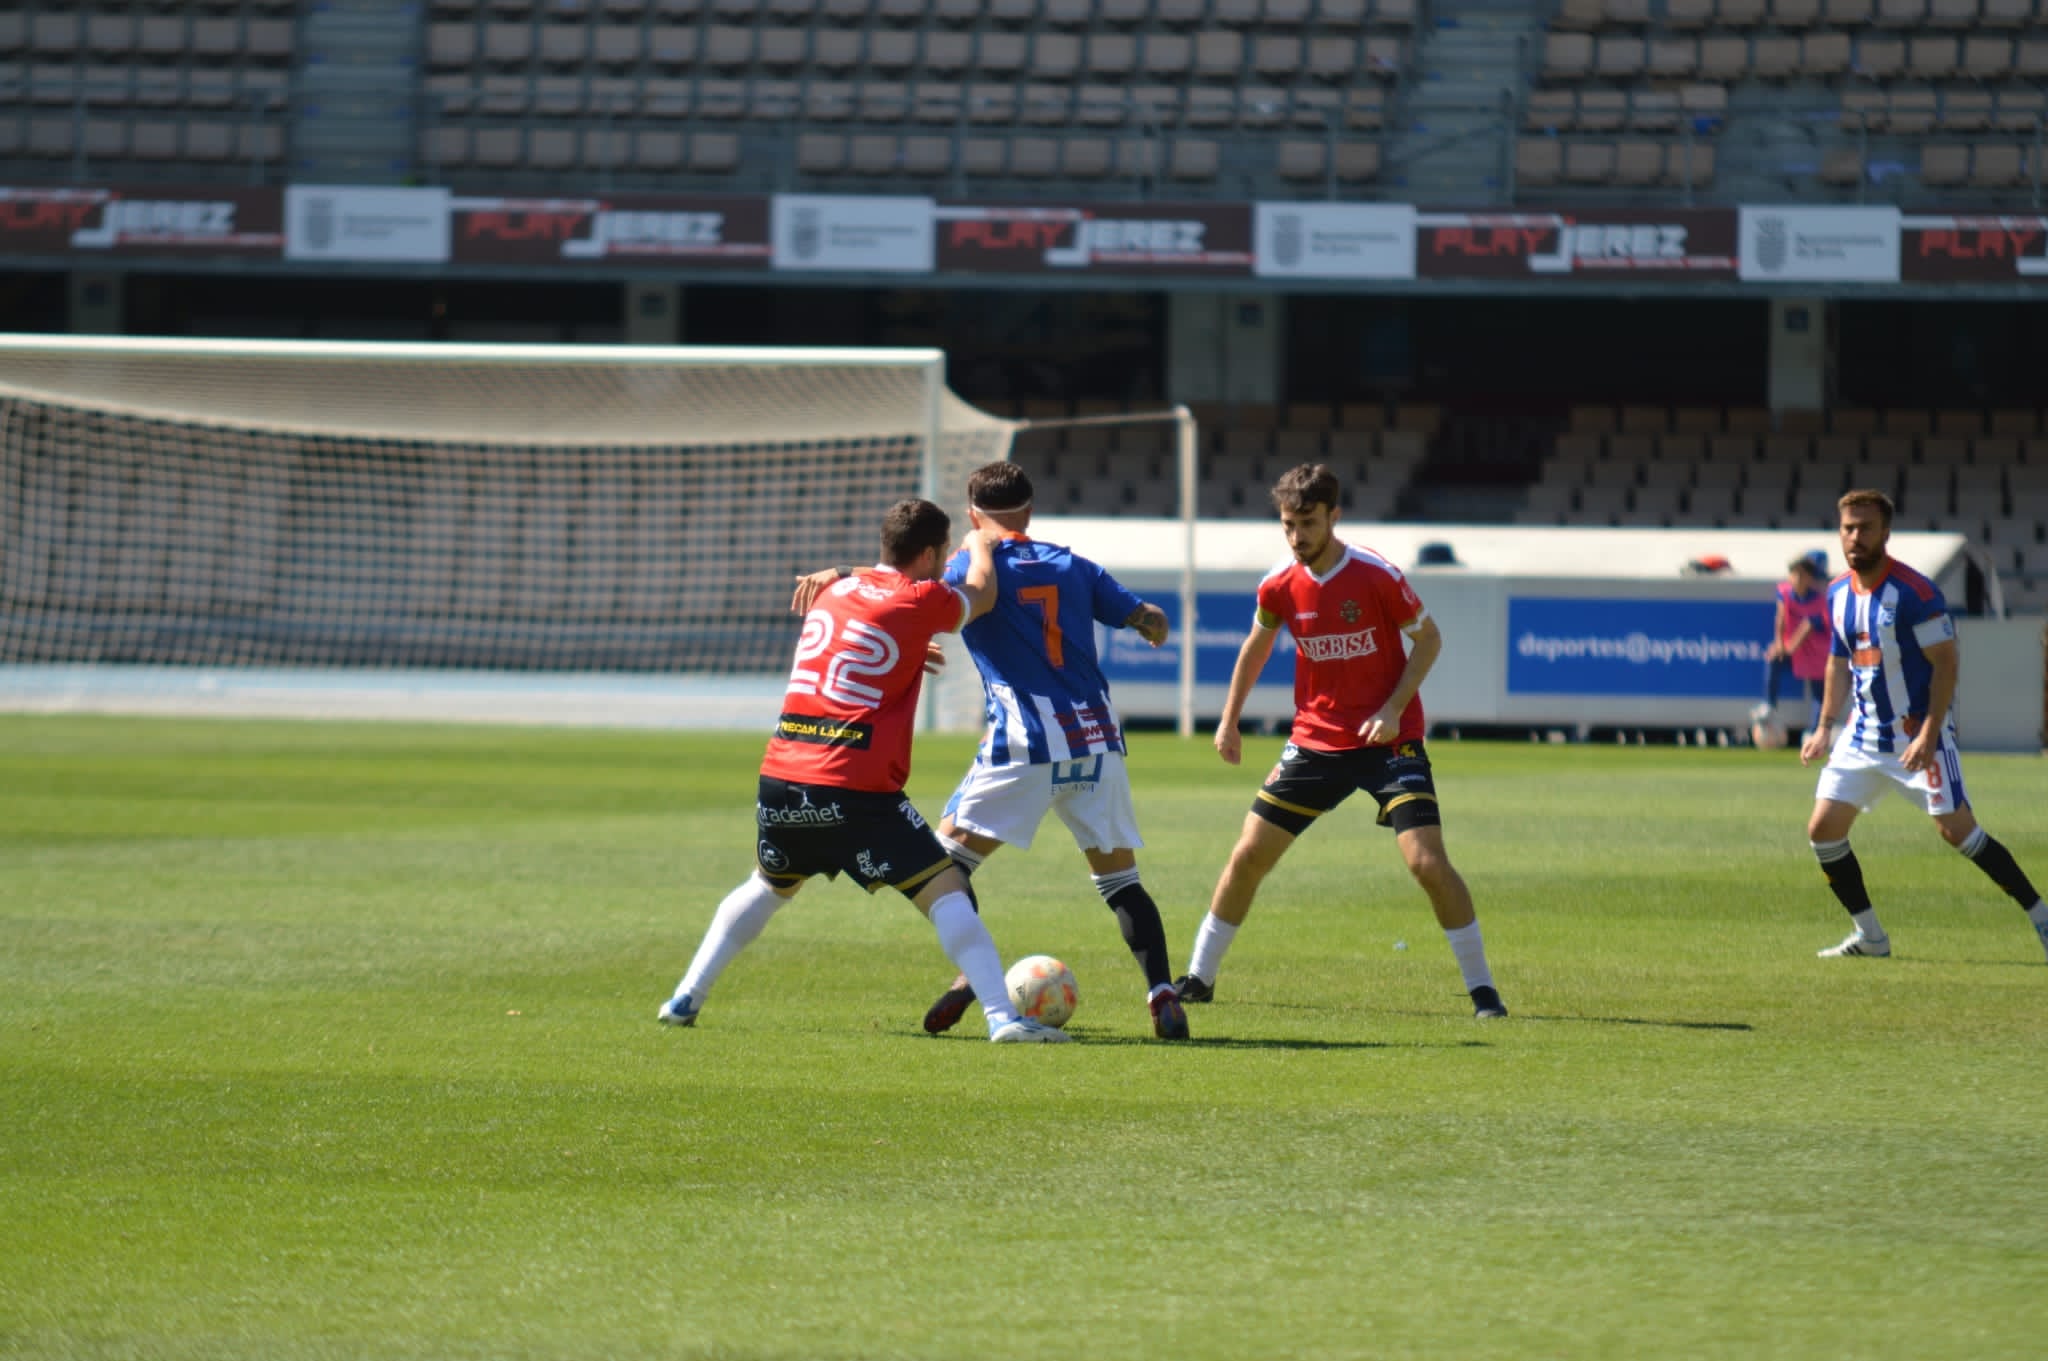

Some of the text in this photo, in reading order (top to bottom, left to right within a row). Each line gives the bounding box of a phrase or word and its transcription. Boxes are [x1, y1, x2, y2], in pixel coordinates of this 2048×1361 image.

[0, 200, 94, 229] LAY
[950, 219, 1068, 249] PLAY
[1043, 218, 1206, 266] JEREZ
[1433, 226, 1549, 256] PLAY
[1527, 224, 1688, 272] JEREZ
[1920, 227, 2038, 258] PLAY
[1016, 584, 1064, 669] 7
[785, 609, 900, 710] 22
[1926, 761, 1943, 788] 8
